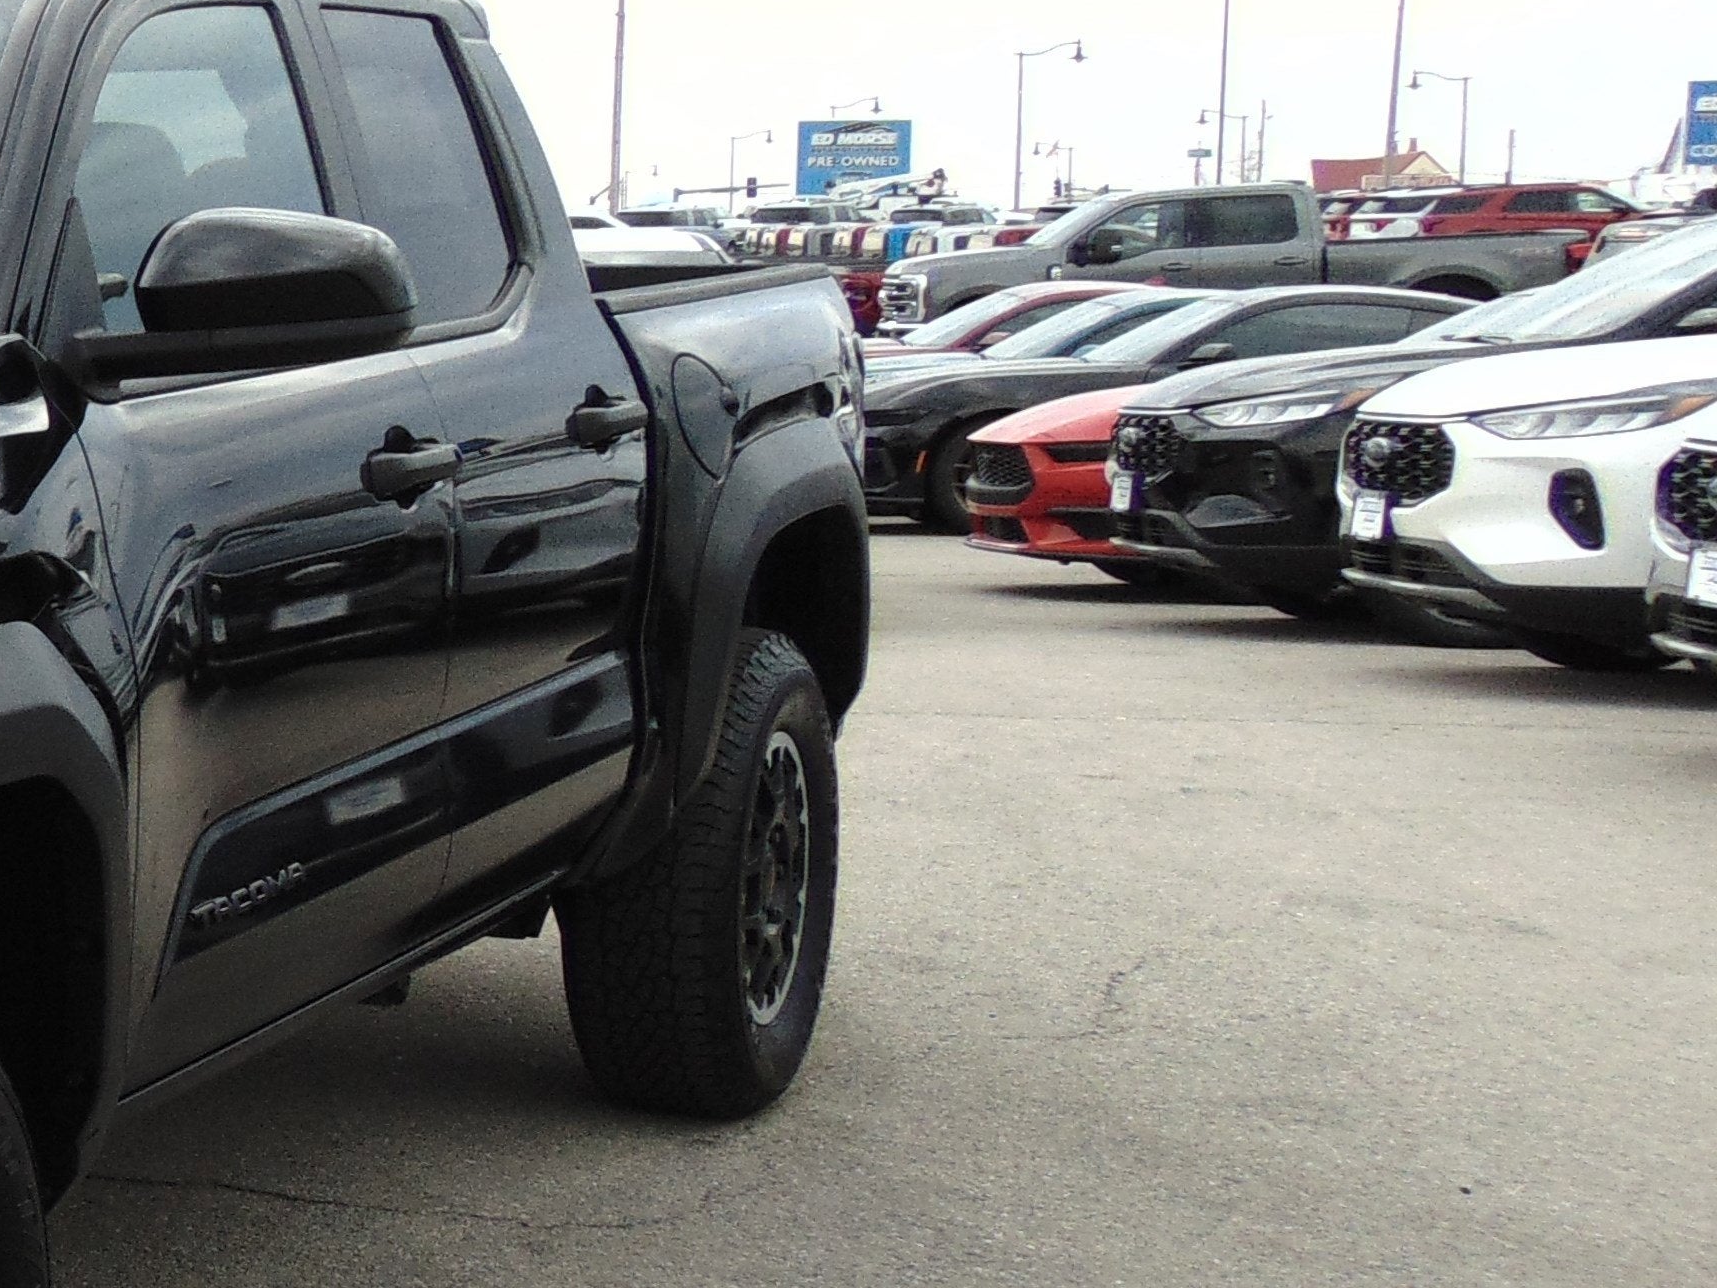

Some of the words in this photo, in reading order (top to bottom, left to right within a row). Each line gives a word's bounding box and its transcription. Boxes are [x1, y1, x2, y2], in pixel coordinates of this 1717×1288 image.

[811, 132, 835, 146] ED
[836, 132, 898, 146] MORSE
[807, 155, 900, 168] PRE-OWNED
[189, 862, 304, 919] TACOMA
